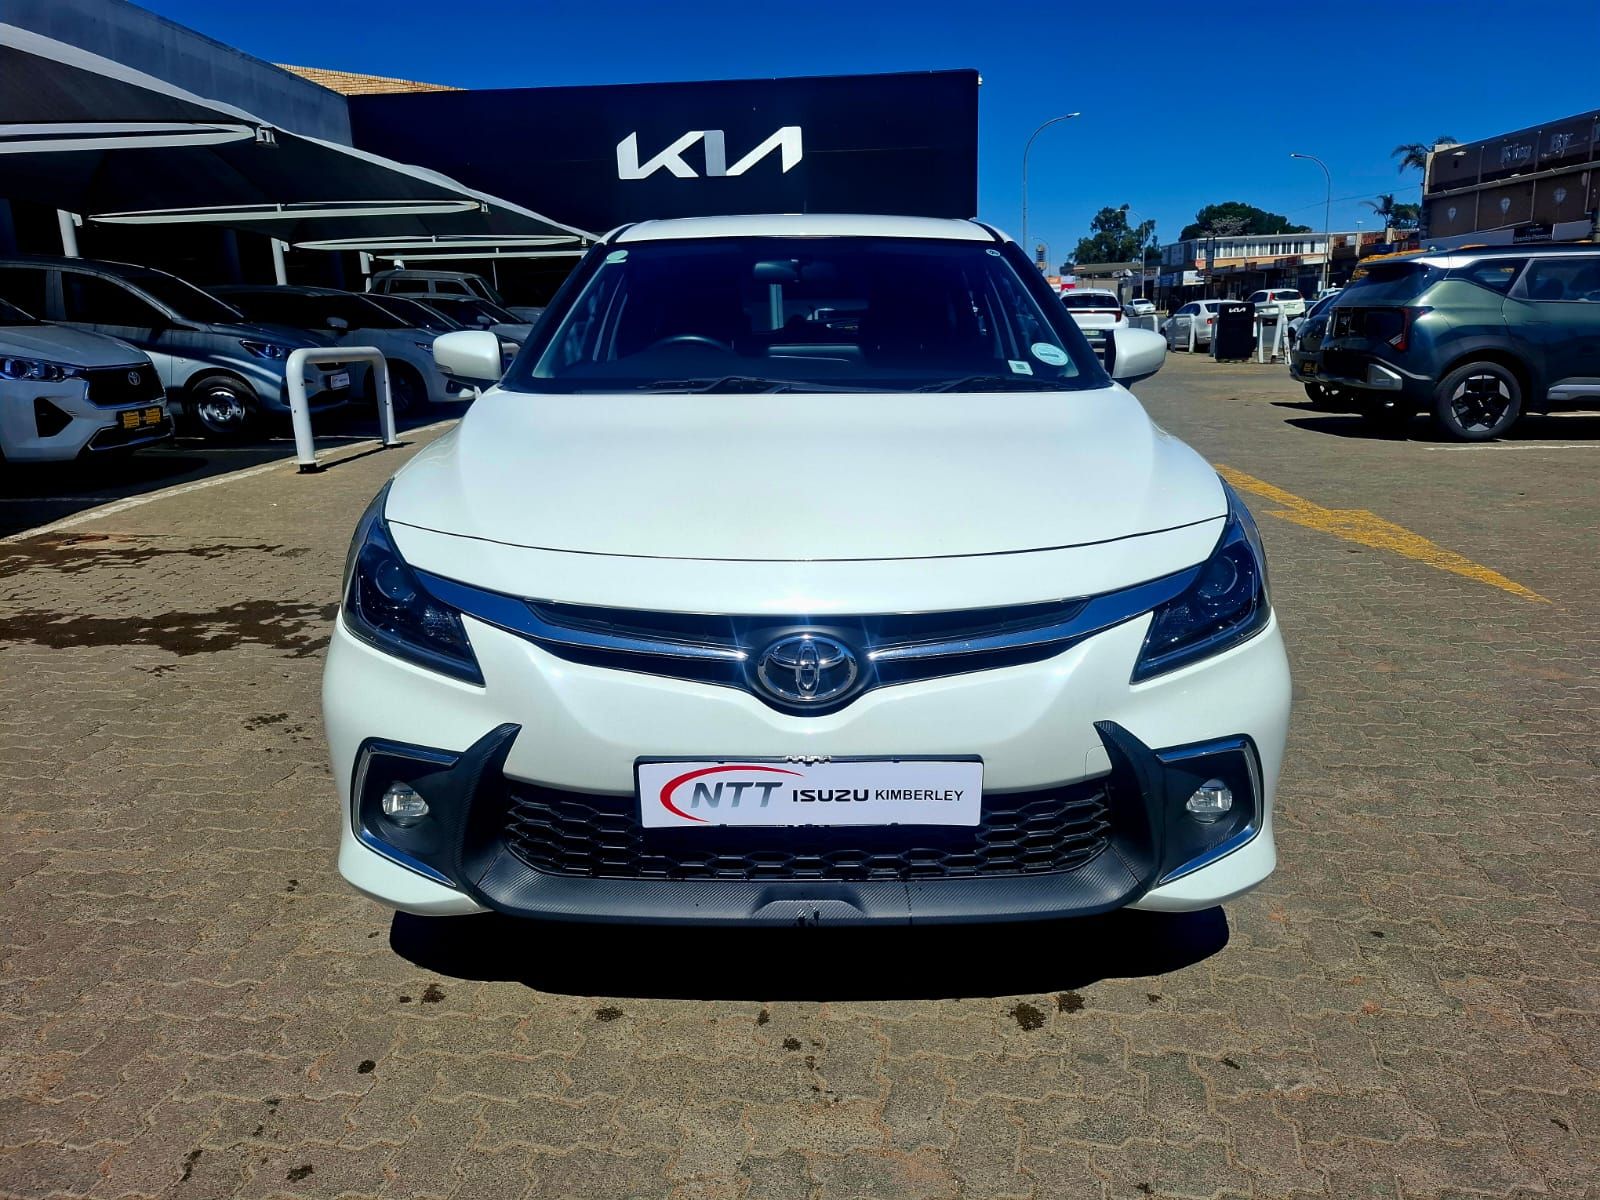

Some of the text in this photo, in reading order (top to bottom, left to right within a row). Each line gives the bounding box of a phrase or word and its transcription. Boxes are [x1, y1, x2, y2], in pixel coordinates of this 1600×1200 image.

[616, 126, 802, 179] KIA
[690, 781, 964, 808] NTT ISUZU KIMBERLEY
